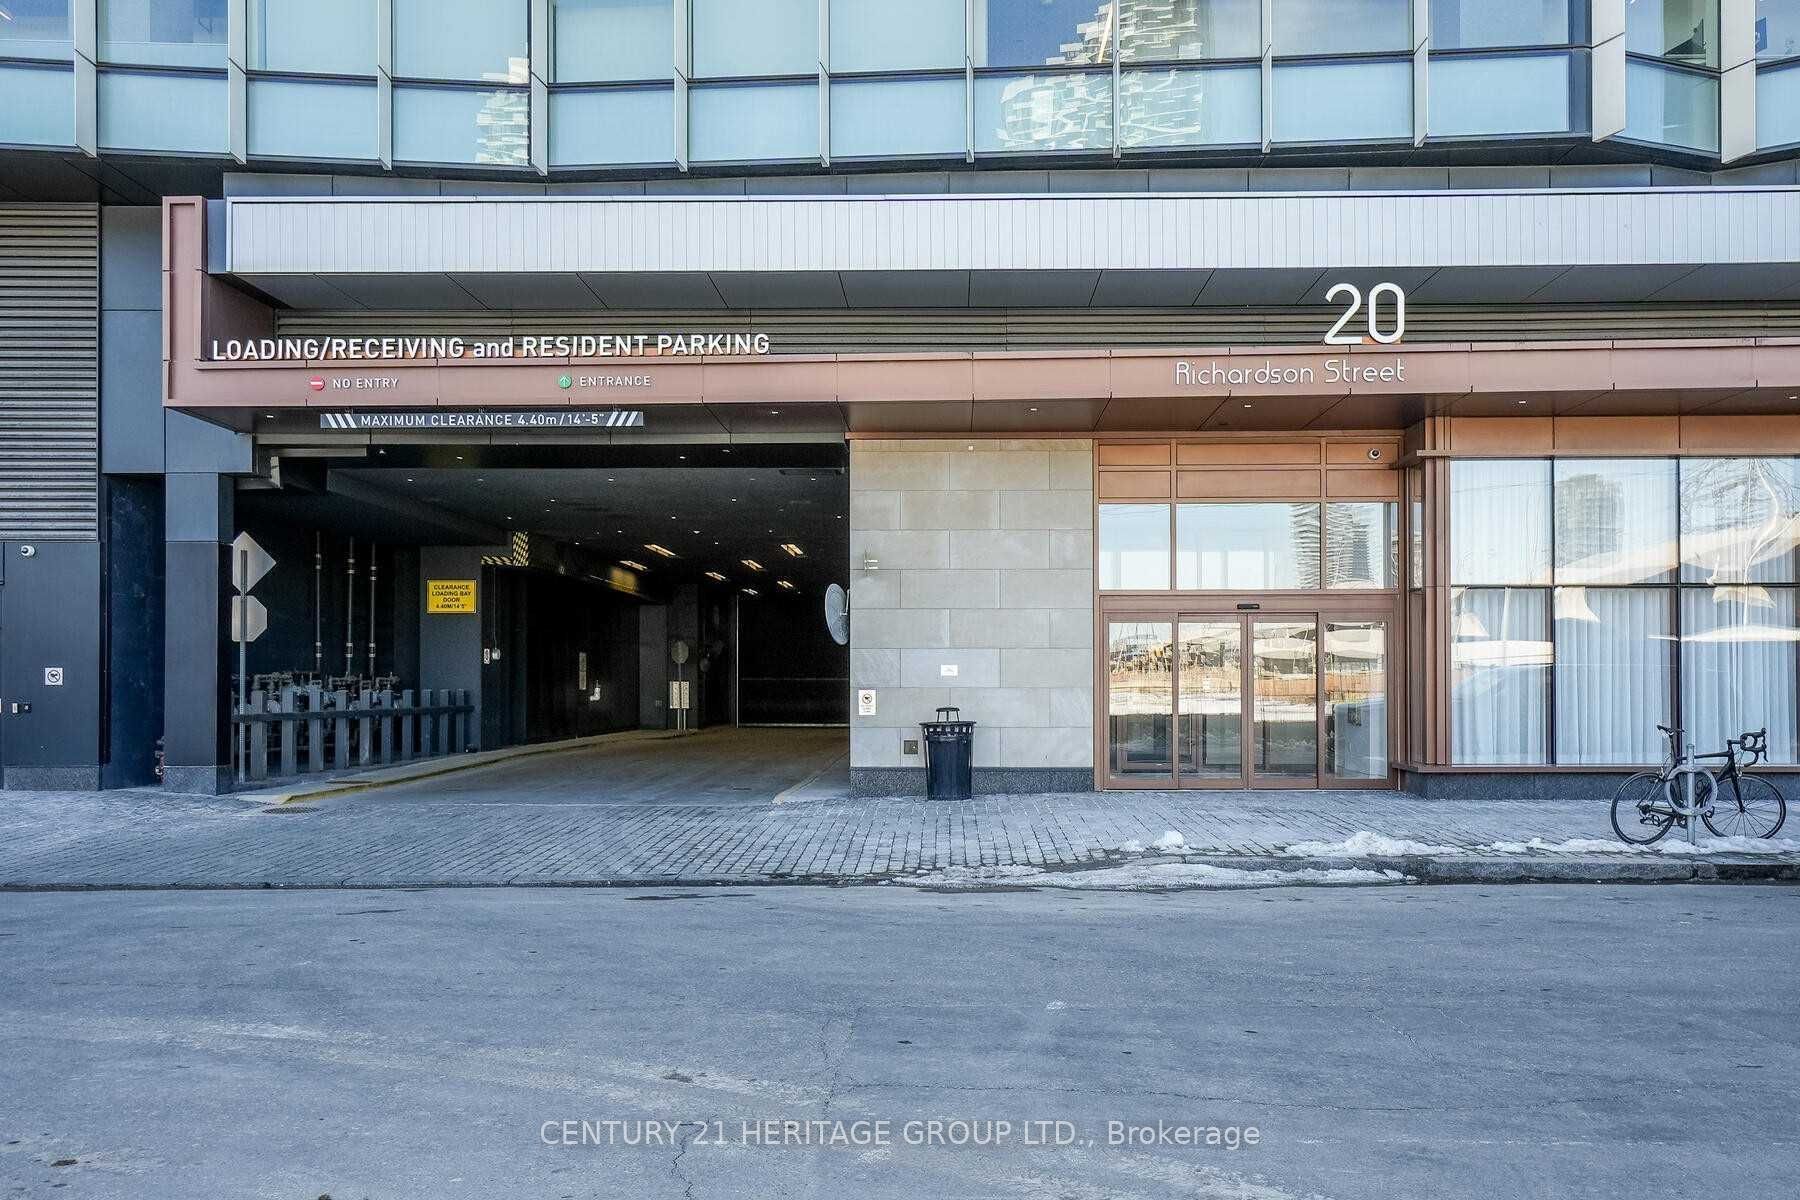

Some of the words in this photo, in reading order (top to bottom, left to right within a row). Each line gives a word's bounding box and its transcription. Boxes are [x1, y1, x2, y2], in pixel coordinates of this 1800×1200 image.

[1324, 282, 1406, 345] 20
[212, 336, 465, 361] LOADING/RECEIVING
[473, 339, 514, 358] and
[522, 335, 649, 358] RESIDENT
[657, 333, 770, 356] PARKING
[579, 375, 651, 388] ENTRANCE
[1175, 360, 1314, 385] Richardson
[1323, 358, 1405, 383] Street
[332, 378, 351, 389] NO
[356, 378, 400, 389] ENTRY
[361, 414, 426, 427] MAXIMUM
[431, 414, 512, 427] CLEARANCE
